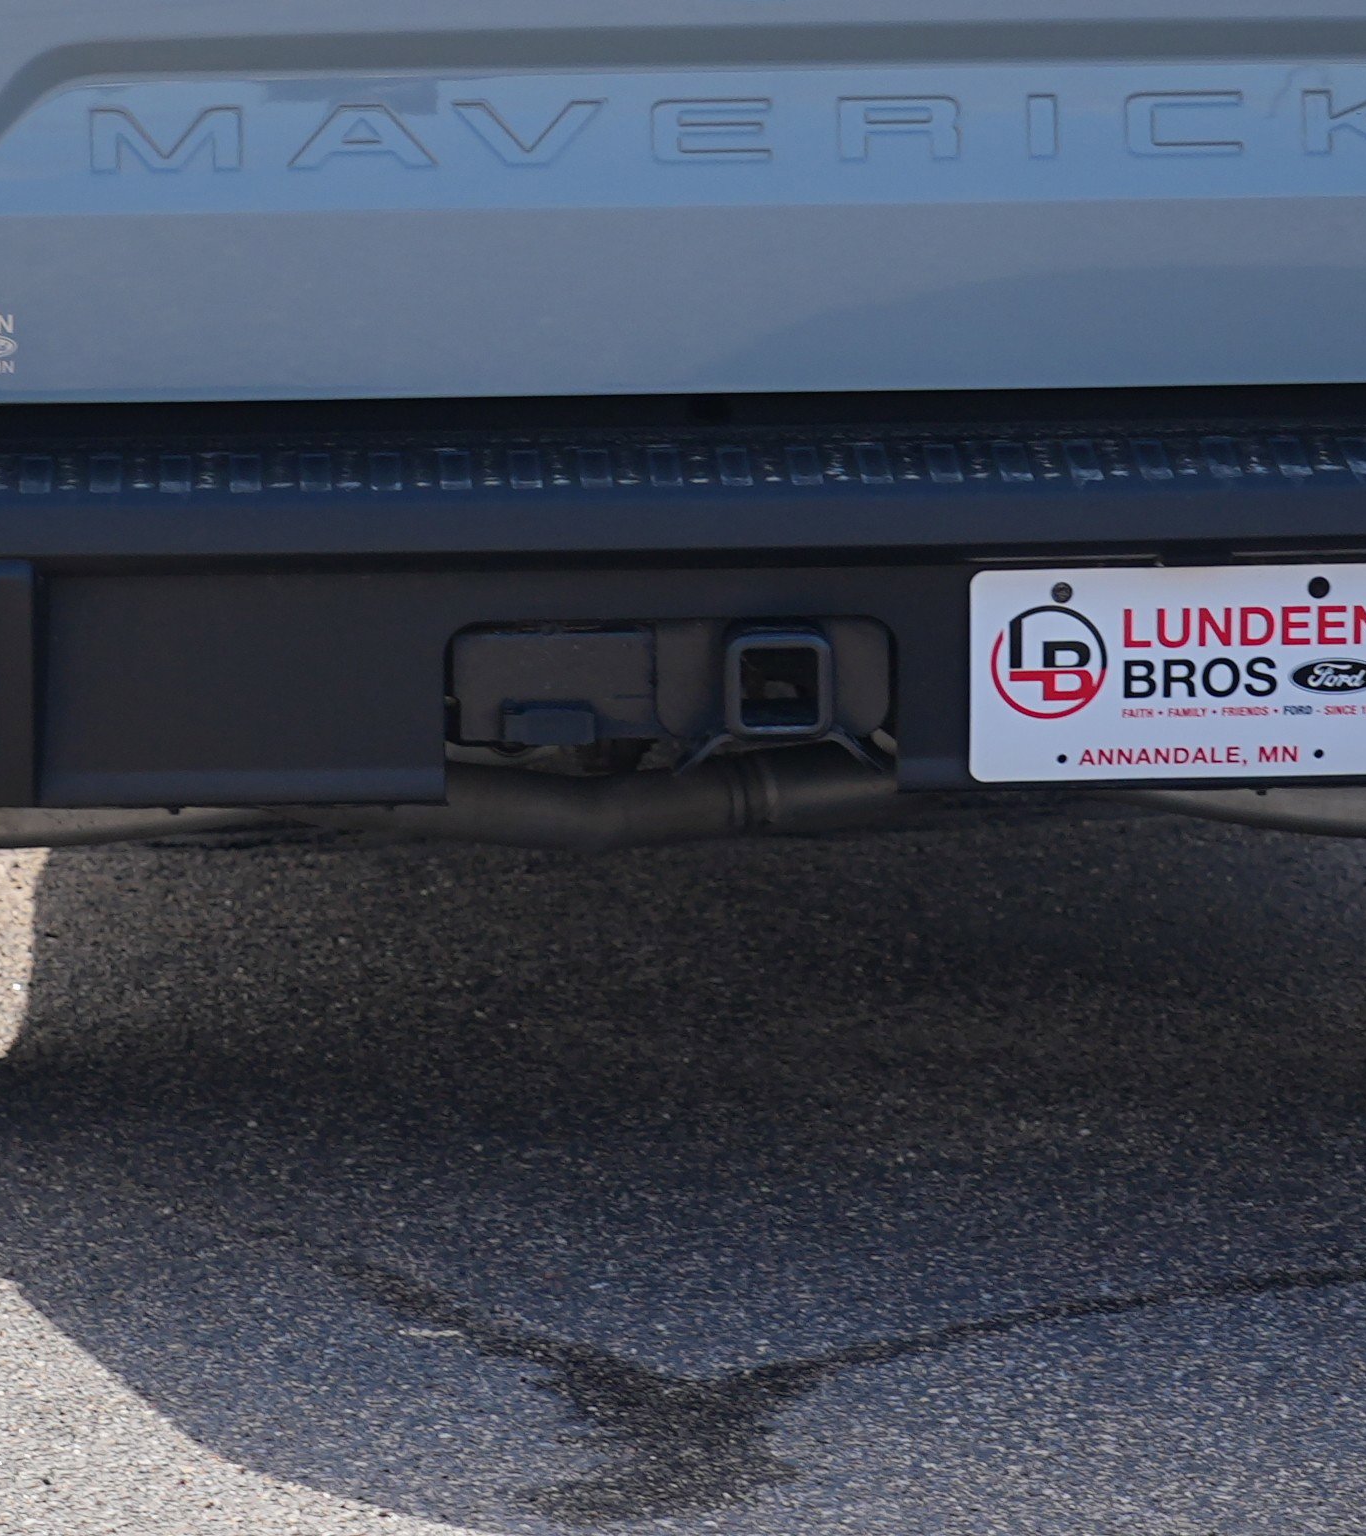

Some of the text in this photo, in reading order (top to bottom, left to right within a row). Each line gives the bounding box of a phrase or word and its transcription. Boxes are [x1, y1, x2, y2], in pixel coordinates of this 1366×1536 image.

[1122, 656, 1278, 700] BROS
[1307, 662, 1366, 688] Ford
[1121, 708, 1154, 718] FAITH
[1167, 707, 1207, 717] FAMILY
[1221, 706, 1270, 717] FRIENDS
[1283, 705, 1314, 716] FORD
[1323, 705, 1358, 716] SINCE
[1078, 745, 1300, 767] ANNANDALE, MN
